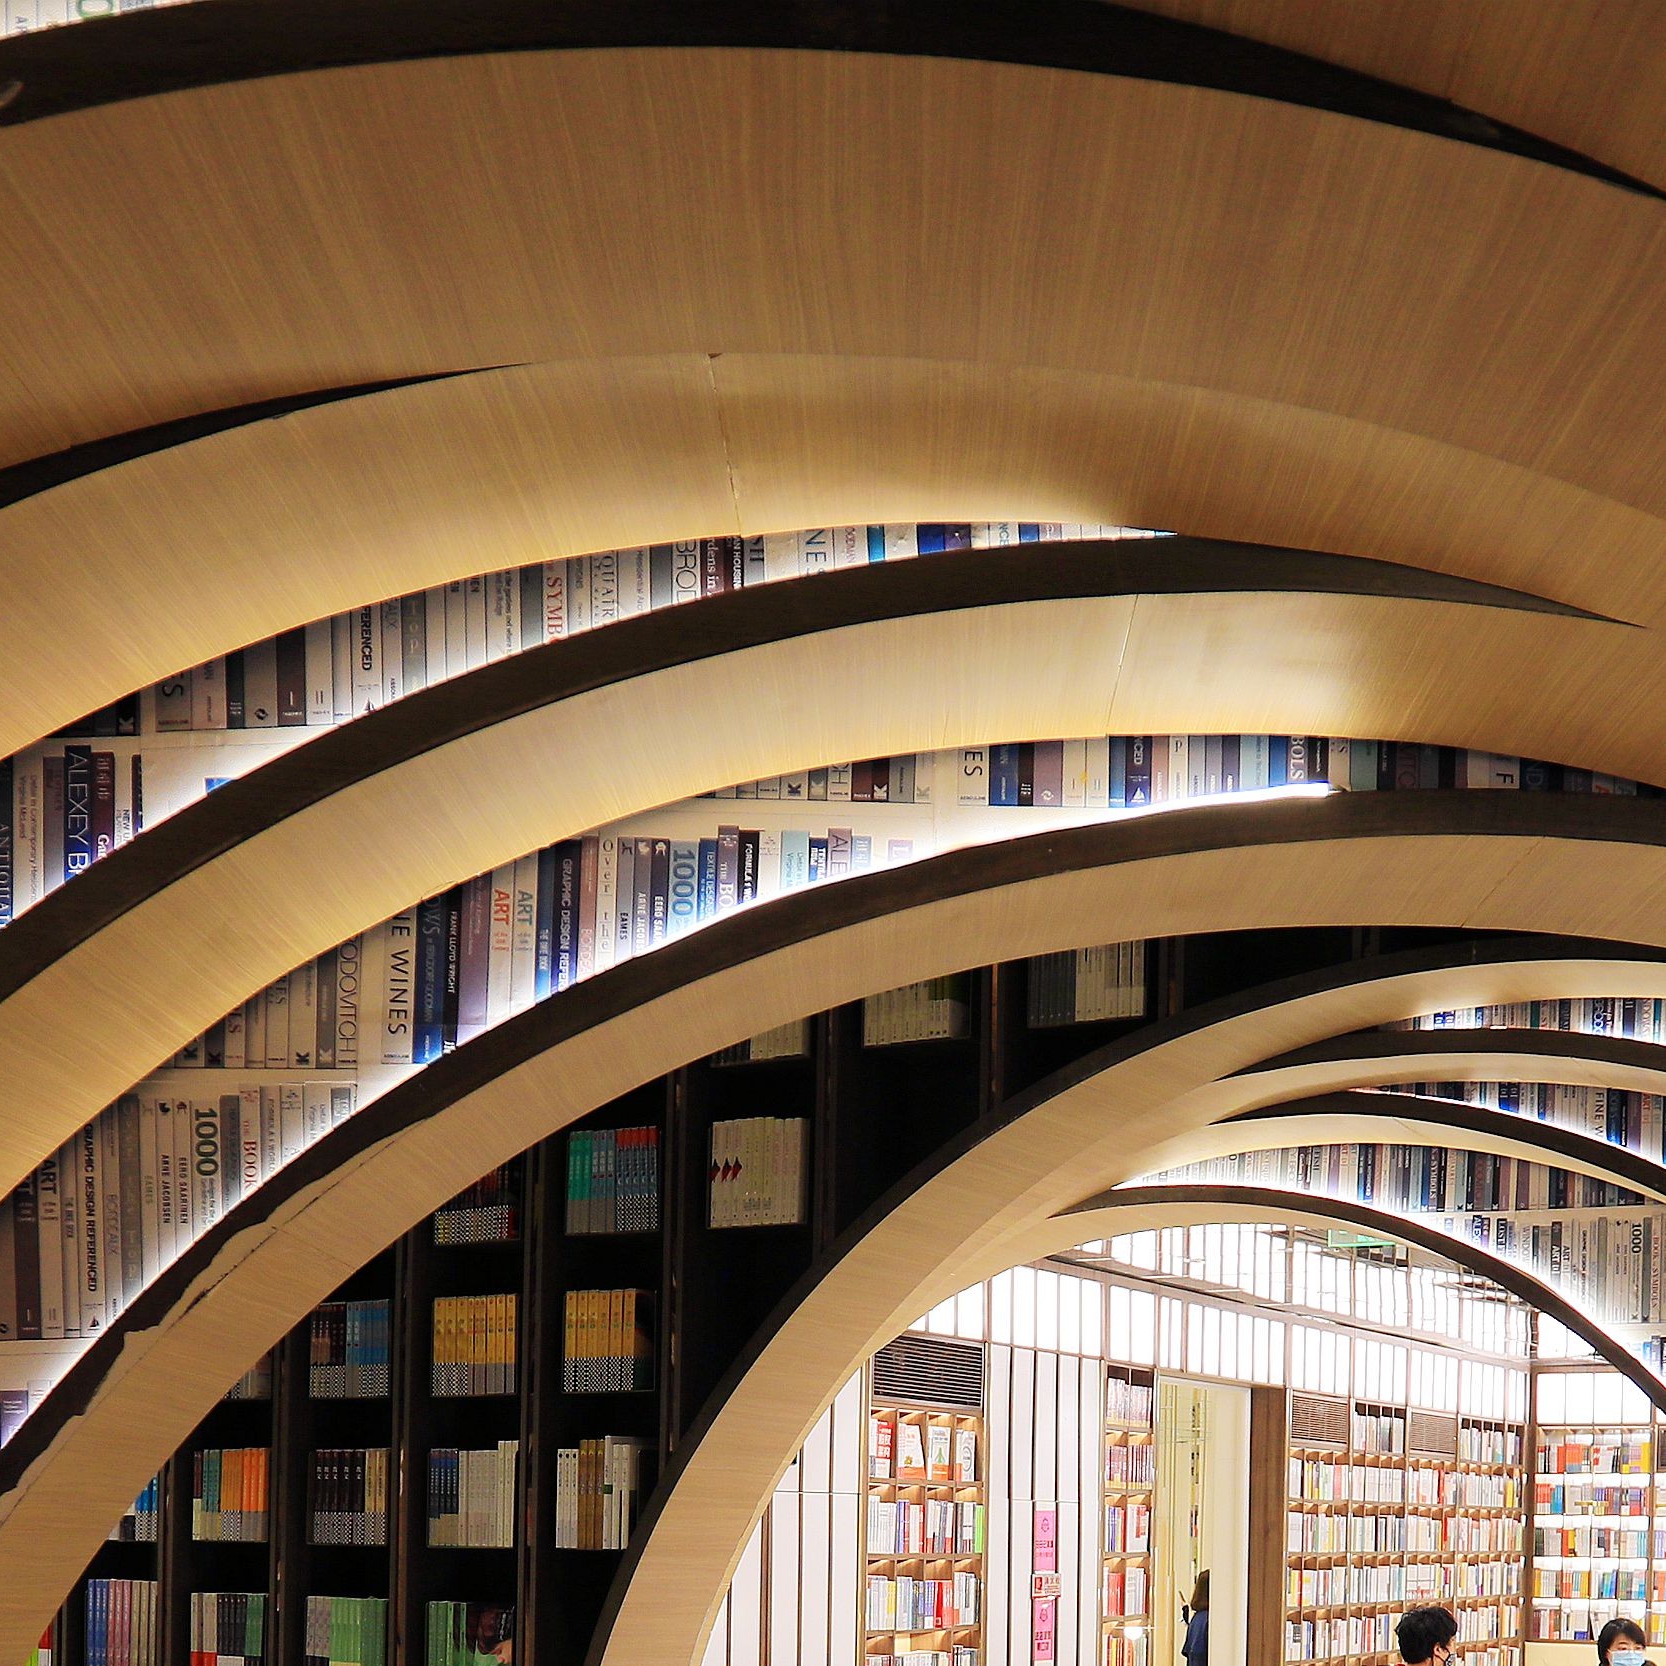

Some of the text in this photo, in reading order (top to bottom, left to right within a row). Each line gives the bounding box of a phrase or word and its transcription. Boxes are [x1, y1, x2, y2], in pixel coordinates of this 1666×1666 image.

[68, 752, 90, 845] ALEXEY
[493, 889, 510, 925] ART
[559, 858, 572, 949] GRAPHIC DESIGN
[672, 849, 696, 919] 1000
[447, 911, 458, 994] FRANK LLOYD WRIGHT
[620, 912, 629, 940] EAMES
[388, 950, 409, 1035] WINES
[195, 1109, 219, 1177] 1000
[244, 1140, 258, 1189] BOOK
[83, 1124, 97, 1292] GRAPHIC DESIGN REFERENCED
[162, 1154, 171, 1224] ARNE JACOBSEN
[179, 1157, 189, 1225] EERO SAARINEN
[1632, 1222, 1642, 1254] 1000
